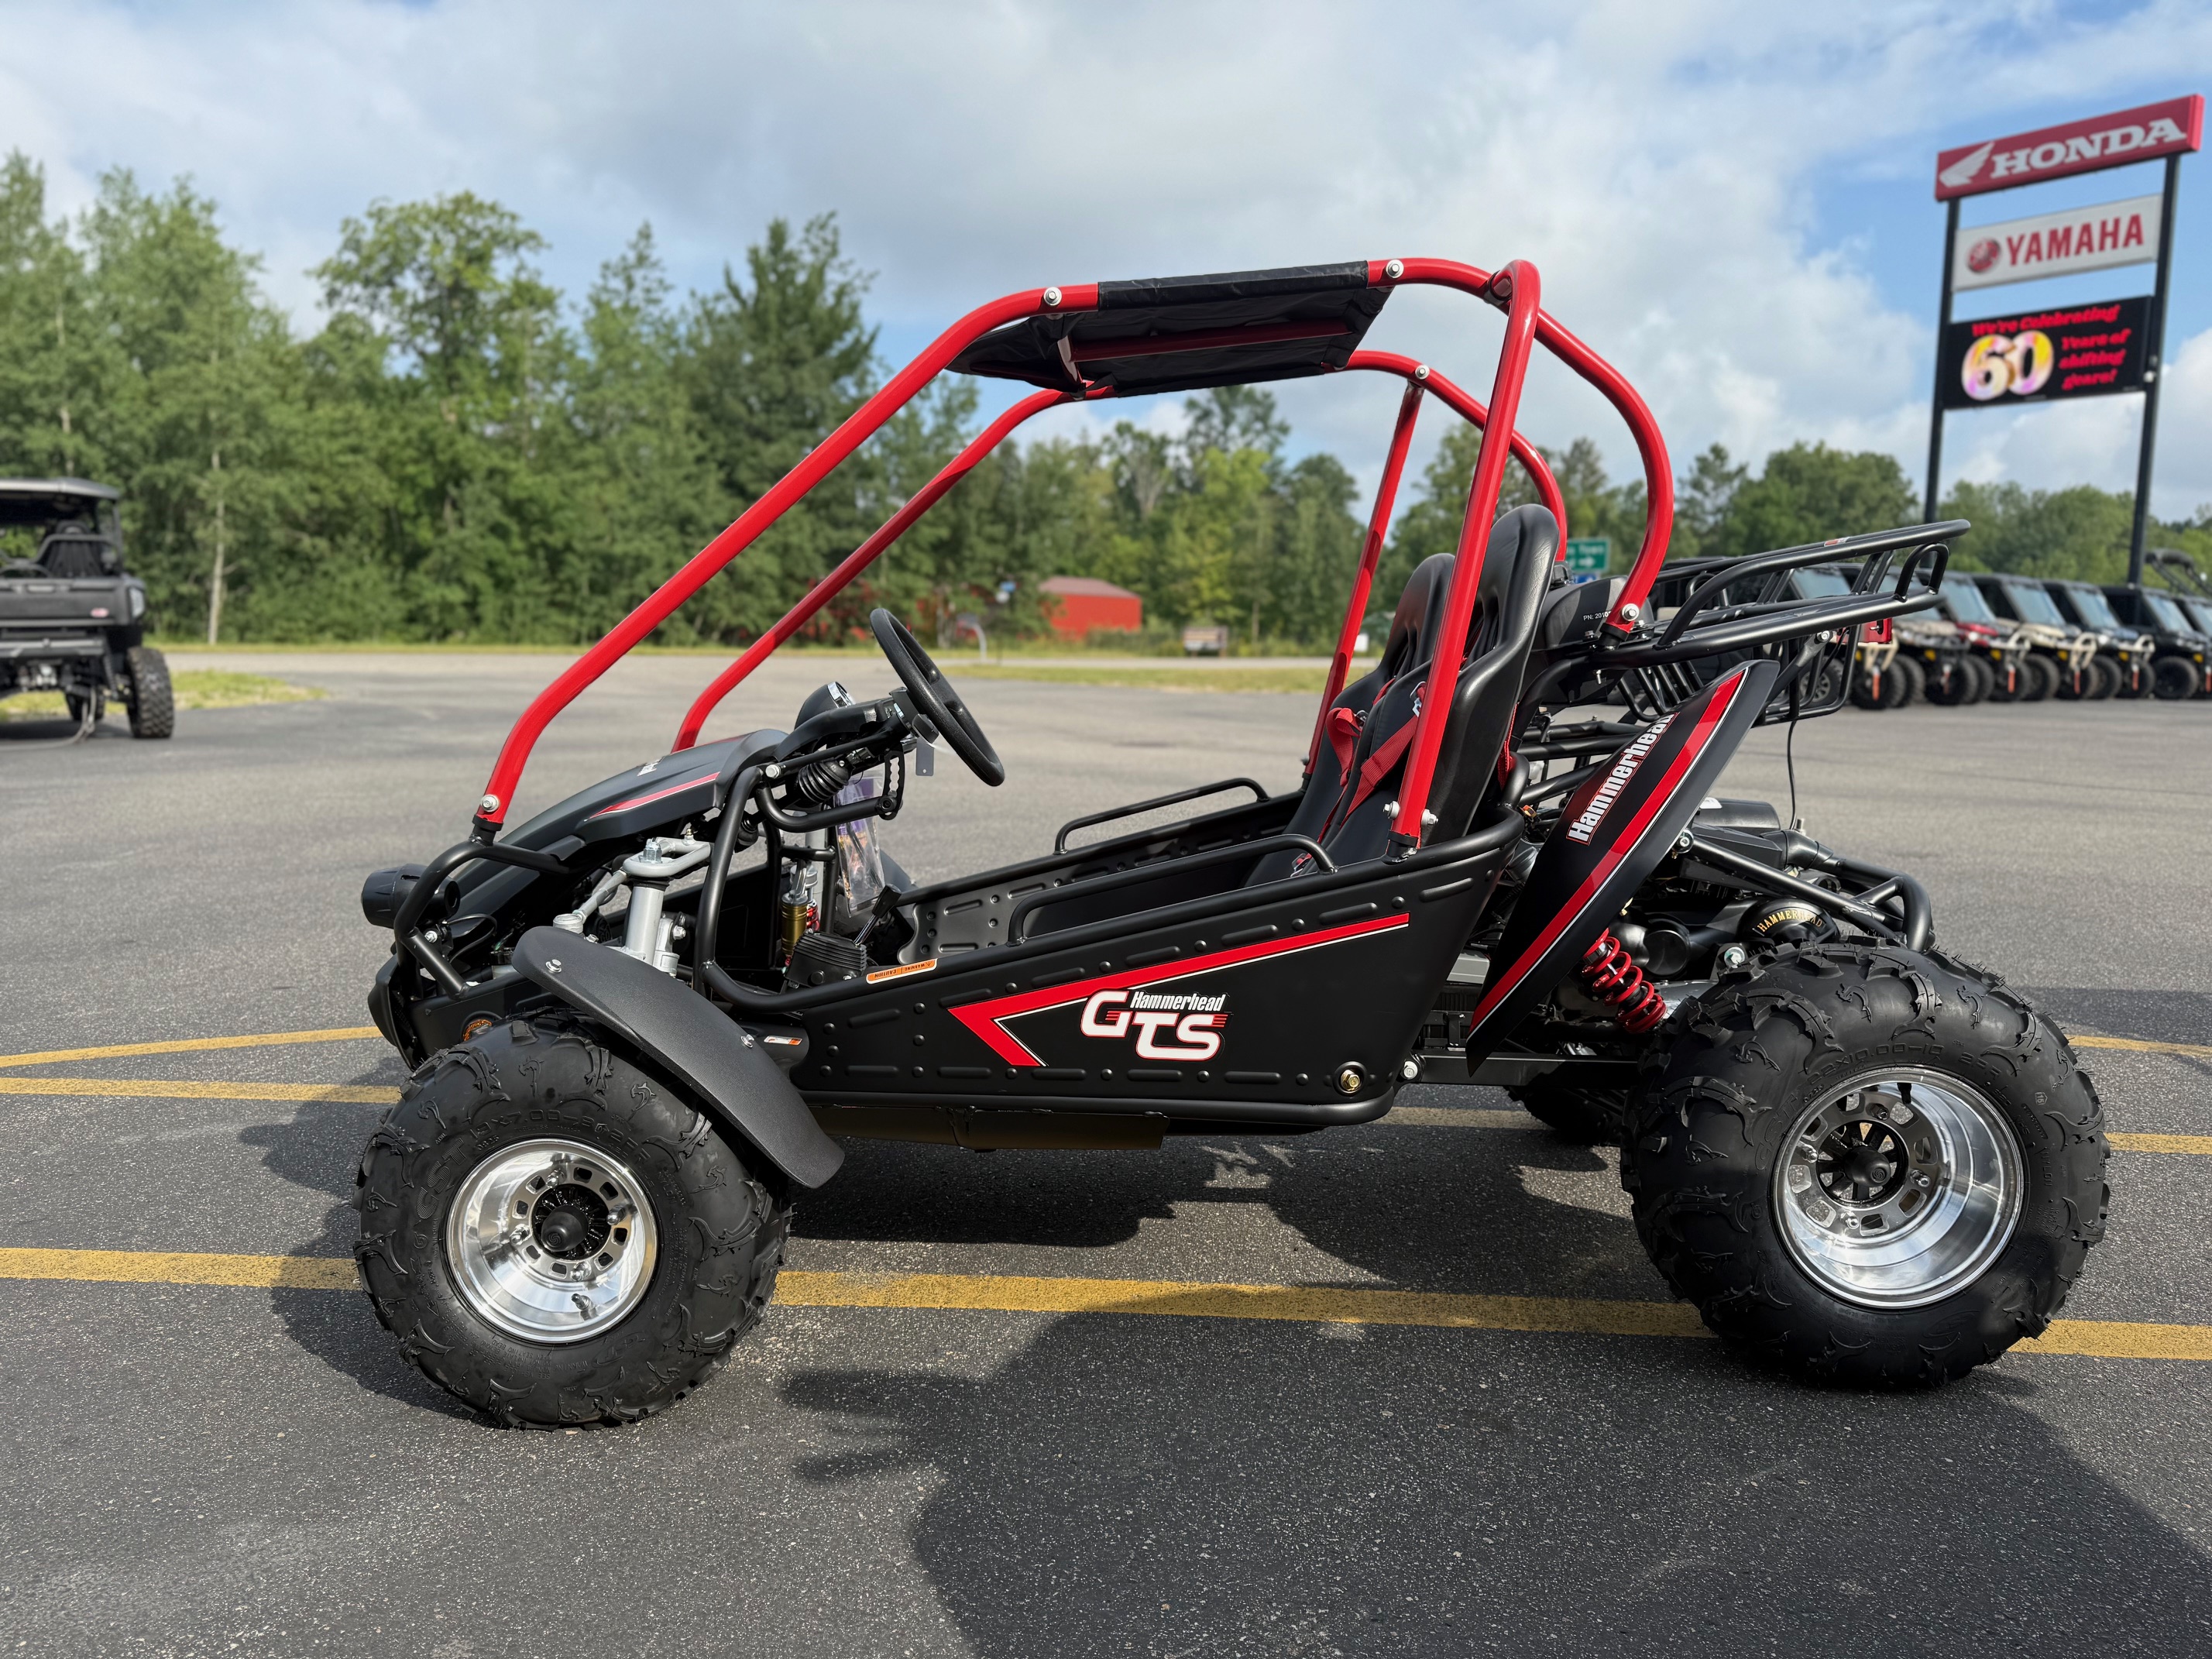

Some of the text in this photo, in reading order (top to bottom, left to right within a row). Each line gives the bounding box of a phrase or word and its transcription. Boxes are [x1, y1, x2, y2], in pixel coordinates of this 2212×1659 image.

[1990, 118, 2186, 178] HONDA
[2006, 213, 2145, 266] YAMAHA
[1961, 330, 2055, 400] 60
[1595, 611, 1611, 620] 2010
[1080, 990, 1228, 1061] GTS
[1129, 991, 1227, 1012] Hammerhead
[415, 1138, 466, 1220] CST
